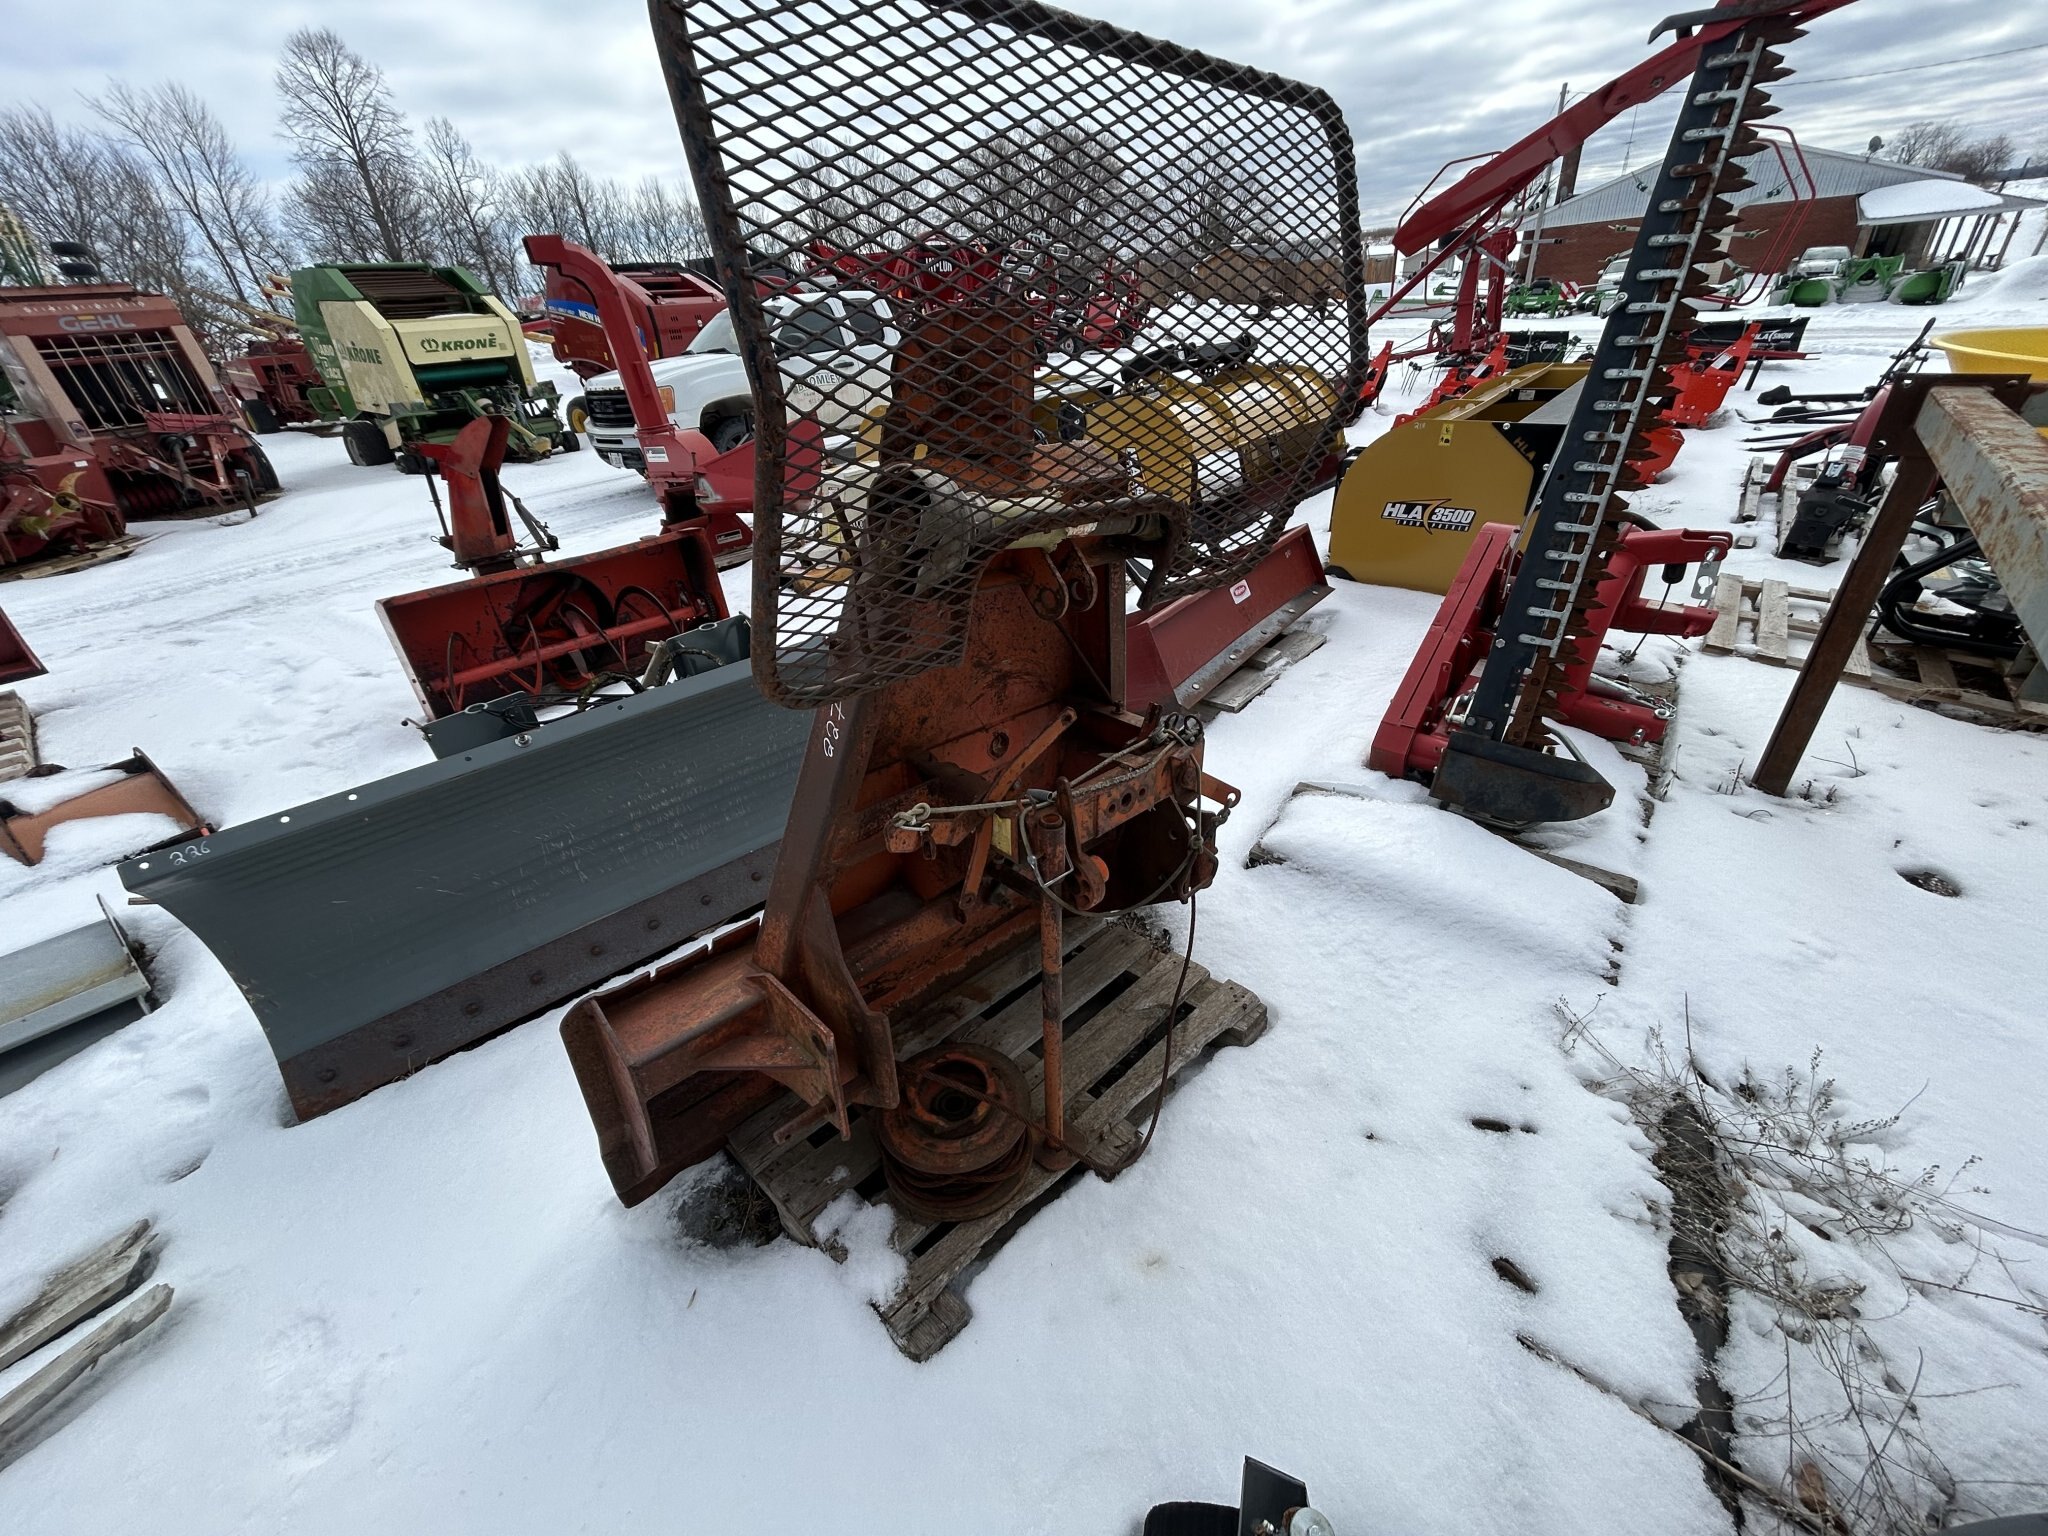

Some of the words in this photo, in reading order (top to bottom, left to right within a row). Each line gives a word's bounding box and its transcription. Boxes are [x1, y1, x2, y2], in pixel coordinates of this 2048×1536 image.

[58, 313, 136, 331] GEHL
[348, 345, 383, 365] KRONE
[1512, 436, 1538, 461] HLA
[1383, 502, 1423, 520] HLA
[1431, 507, 1475, 525] 3500
[169, 840, 211, 866] 226
